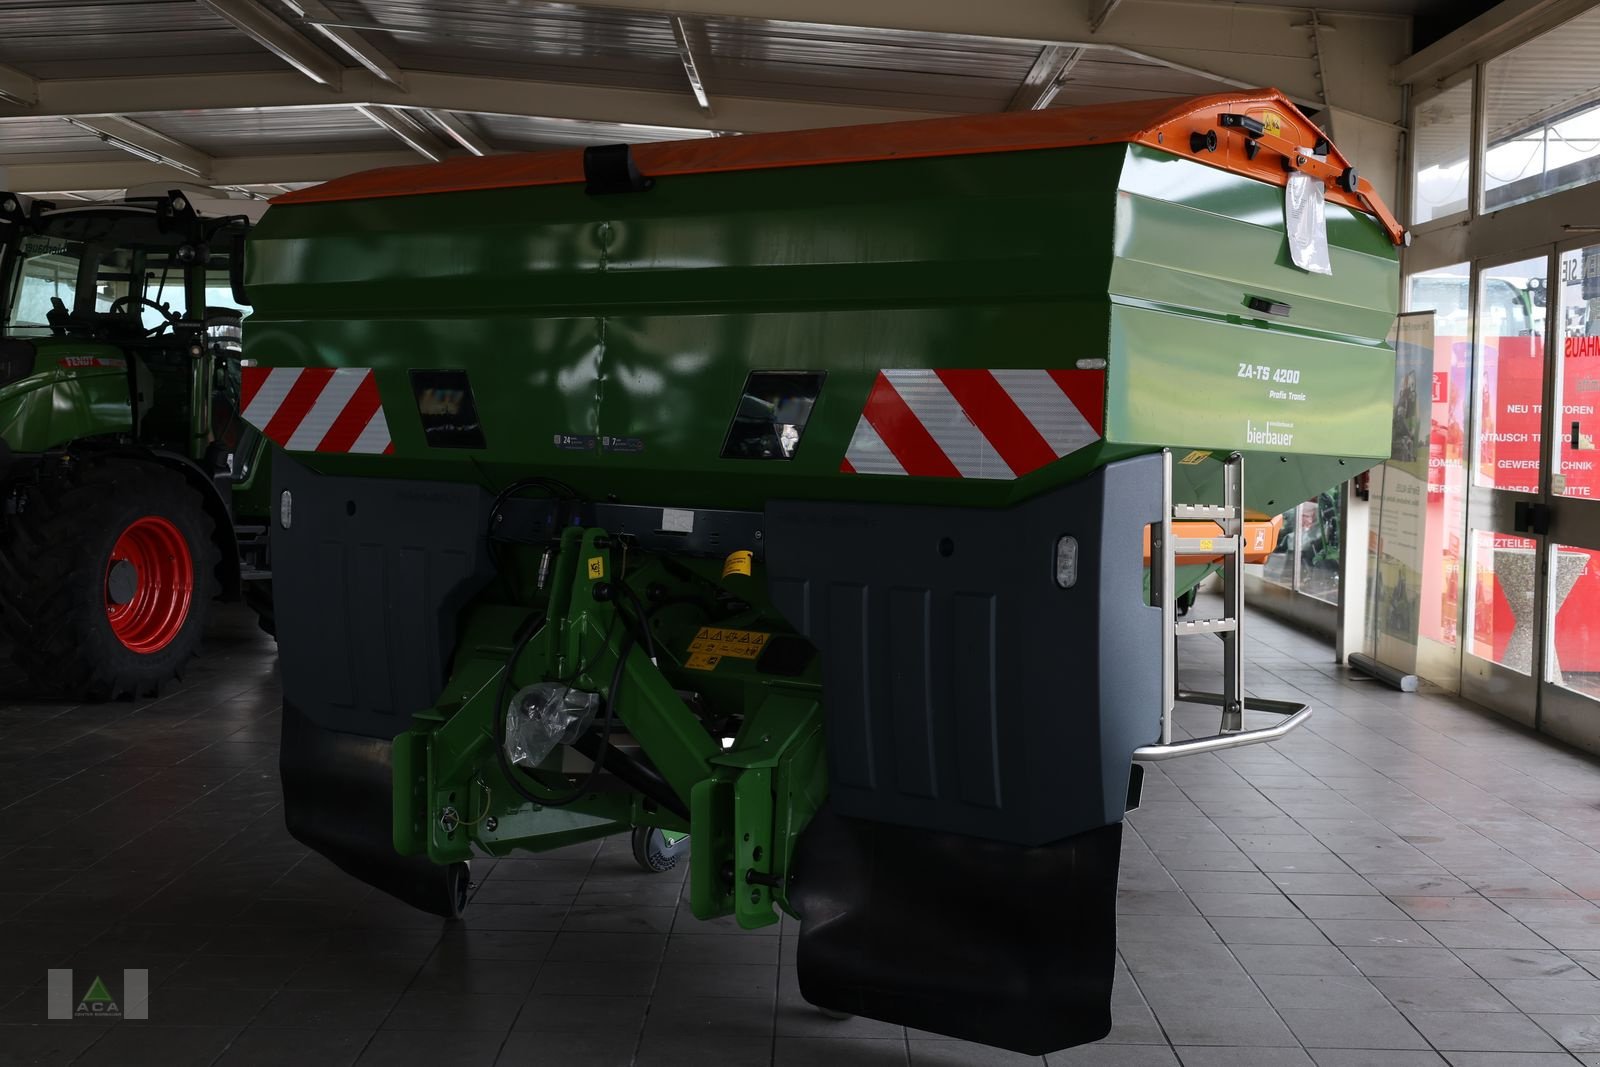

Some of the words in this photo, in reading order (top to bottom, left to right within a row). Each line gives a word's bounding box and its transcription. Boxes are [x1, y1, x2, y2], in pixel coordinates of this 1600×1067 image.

[65, 355, 94, 367] FENDT
[1238, 363, 1270, 380] ZA-TS
[1273, 368, 1300, 384] 4200
[1269, 390, 1286, 399] Profis
[1289, 392, 1306, 401] Tronic
[1507, 405, 1528, 414] NEU
[1247, 420, 1293, 446] bierbauer
[1480, 433, 1527, 443] NTAUSCH
